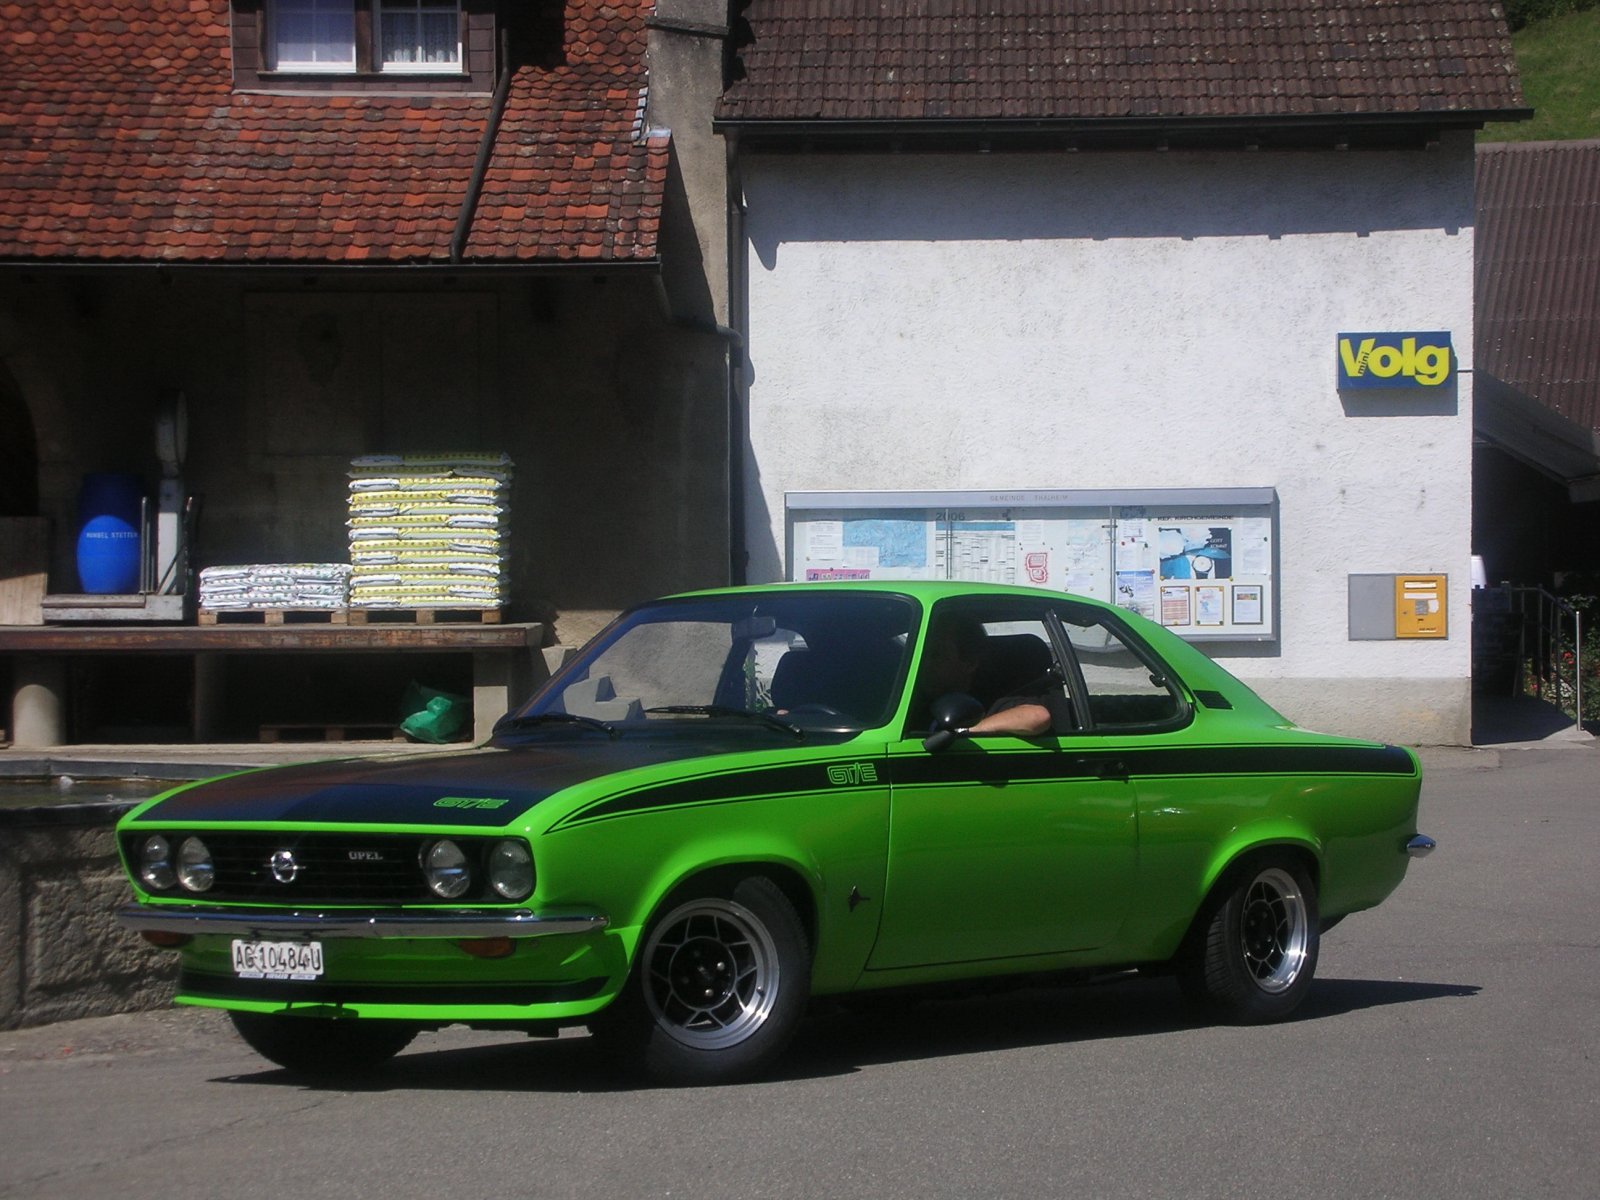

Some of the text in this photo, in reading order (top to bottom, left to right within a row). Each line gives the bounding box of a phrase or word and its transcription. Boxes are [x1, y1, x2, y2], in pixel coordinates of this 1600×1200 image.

[1339, 337, 1450, 386] Volg
[1357, 351, 1370, 375] mini
[989, 494, 1025, 502] GEMEINDE
[936, 511, 966, 521] 2006
[348, 850, 384, 860] OPEL
